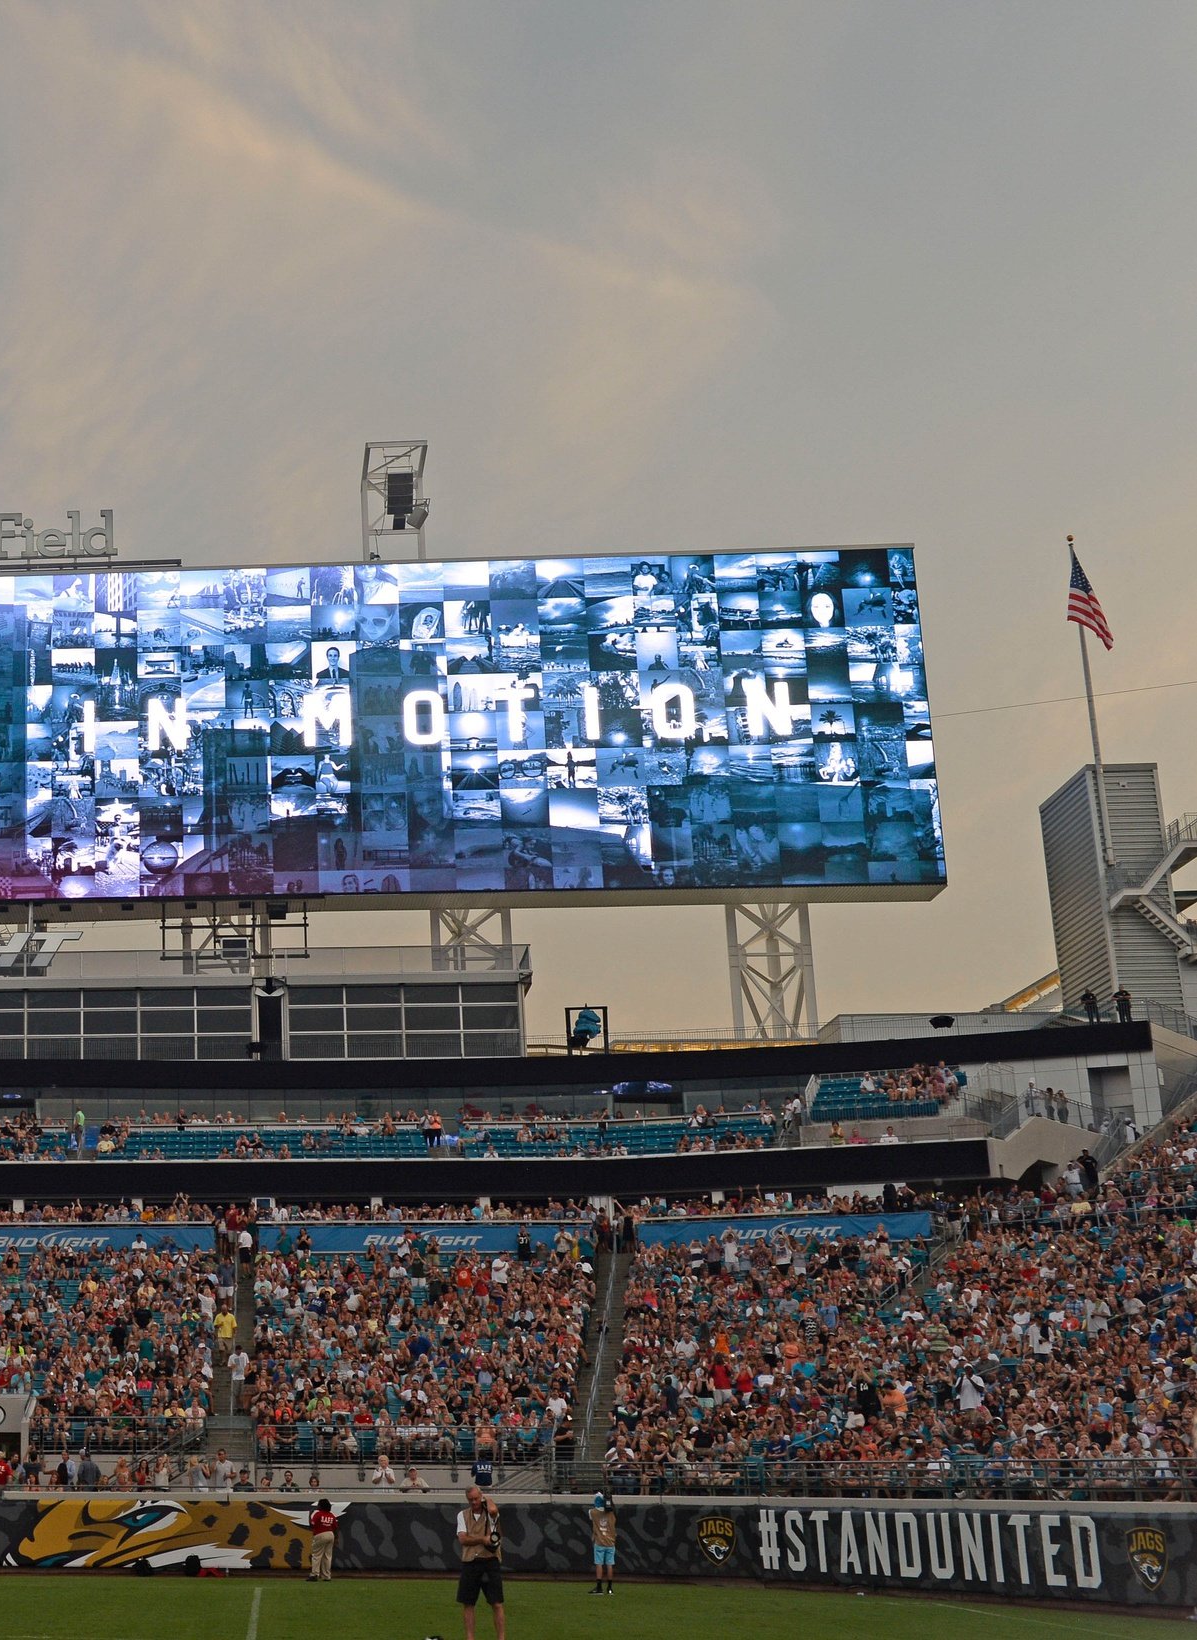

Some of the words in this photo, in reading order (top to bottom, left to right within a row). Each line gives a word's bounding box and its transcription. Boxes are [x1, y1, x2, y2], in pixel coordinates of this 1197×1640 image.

[83, 697, 189, 753] IN
[303, 681, 793, 748] MOTION
[47, 1236, 110, 1247] LIGHT
[699, 1520, 733, 1537] JAGS
[758, 1509, 1102, 1589] #STANDUNITED
[1129, 1531, 1164, 1553] JAGS
